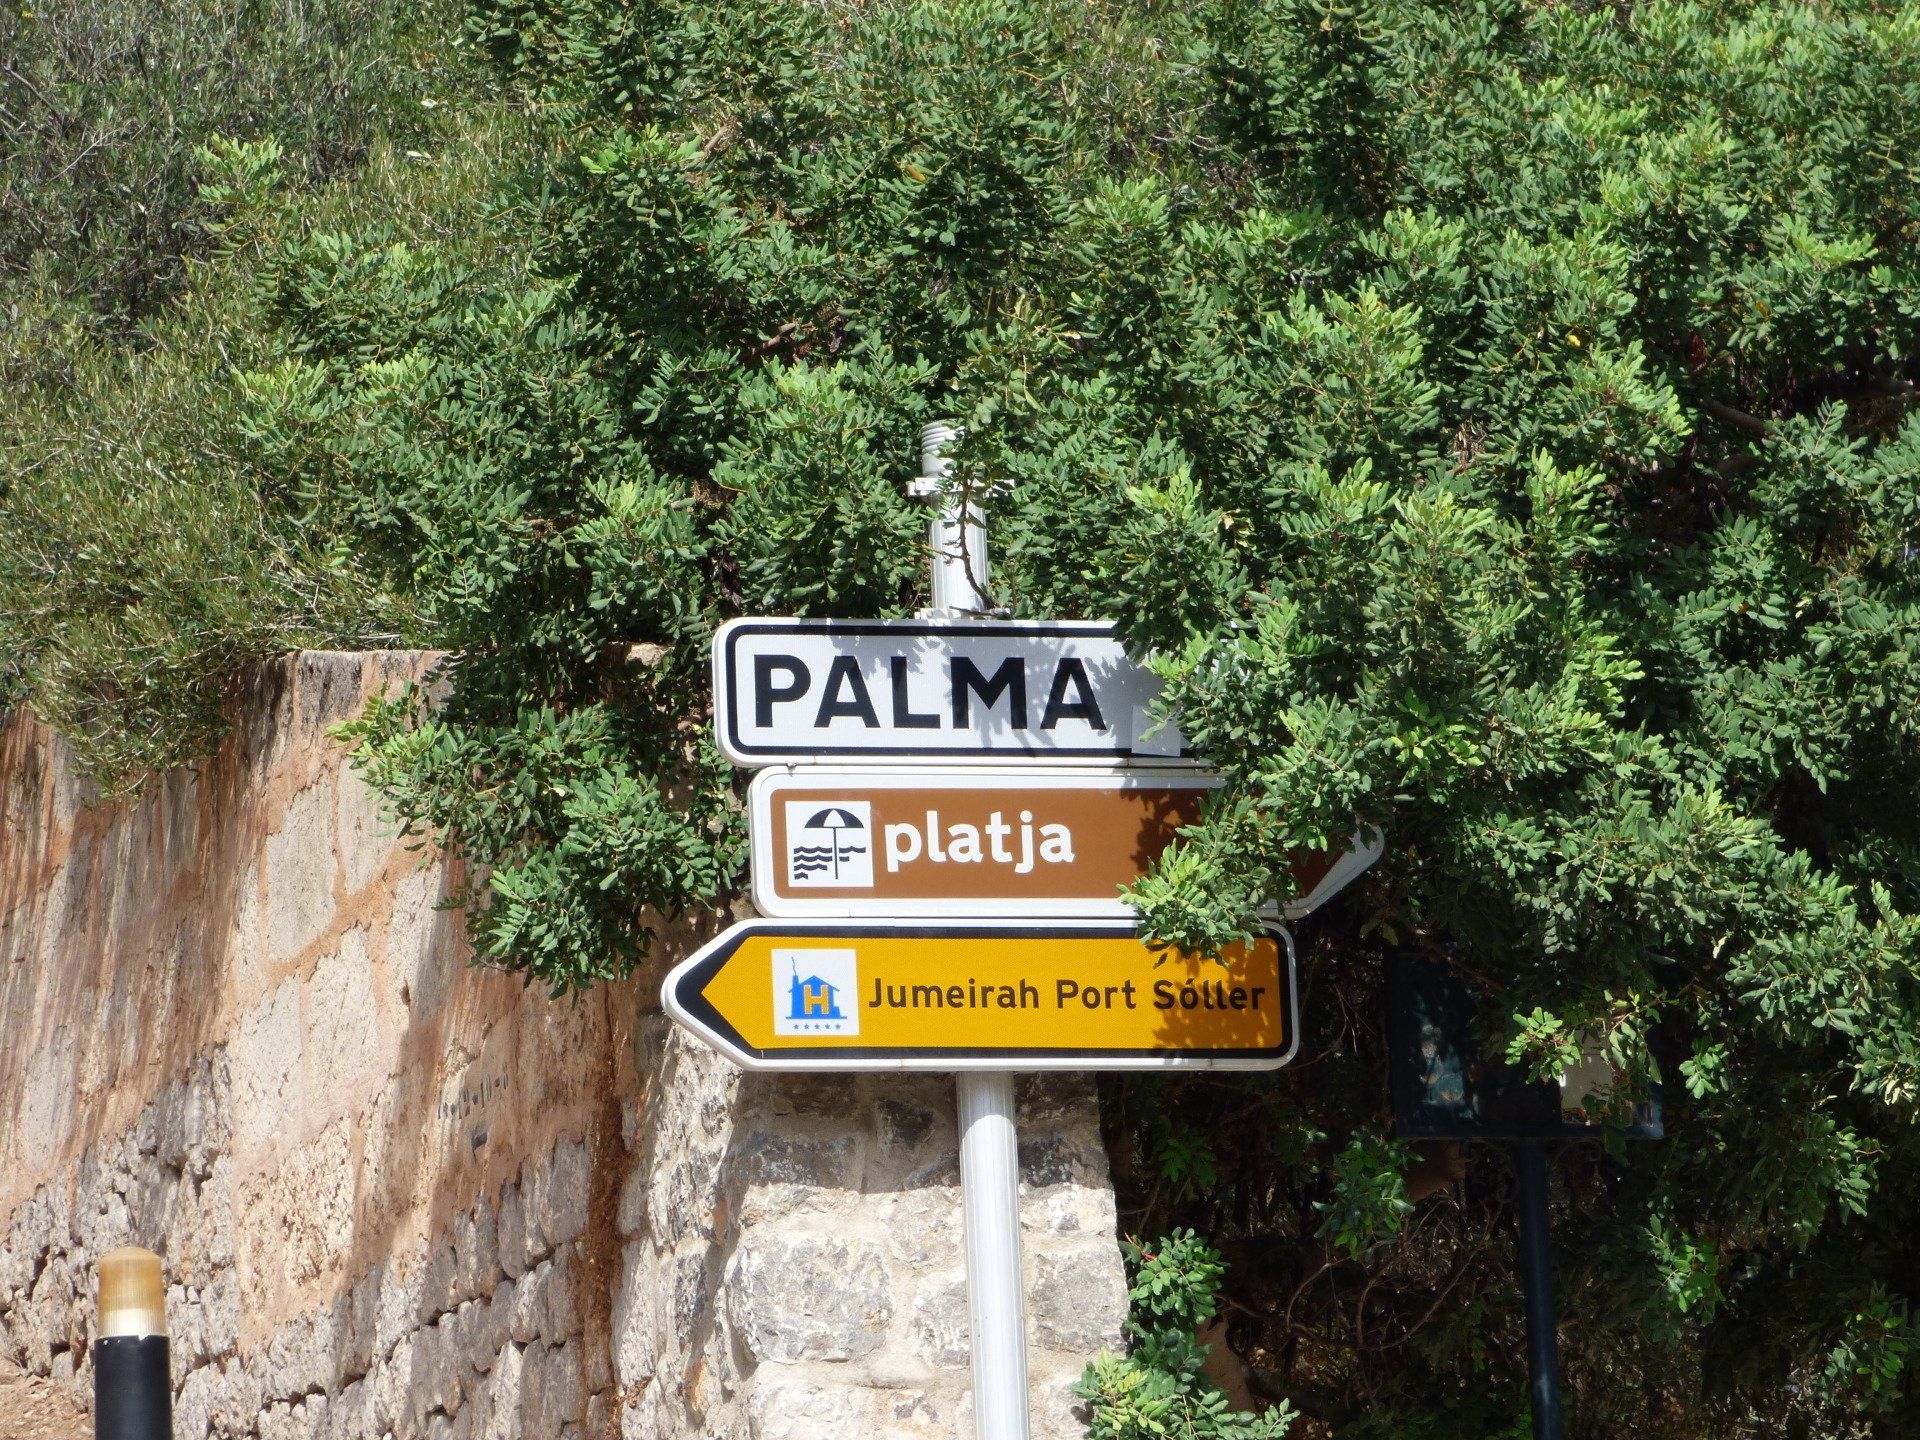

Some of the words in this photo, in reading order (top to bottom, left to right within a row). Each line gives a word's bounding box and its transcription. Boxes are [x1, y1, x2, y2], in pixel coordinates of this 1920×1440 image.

[754, 654, 1108, 731] PALMA
[884, 809, 1076, 874] platja
[868, 978, 1039, 1009] Jumeirah
[1056, 979, 1136, 1010] Port
[1153, 977, 1266, 1011] Sóller
